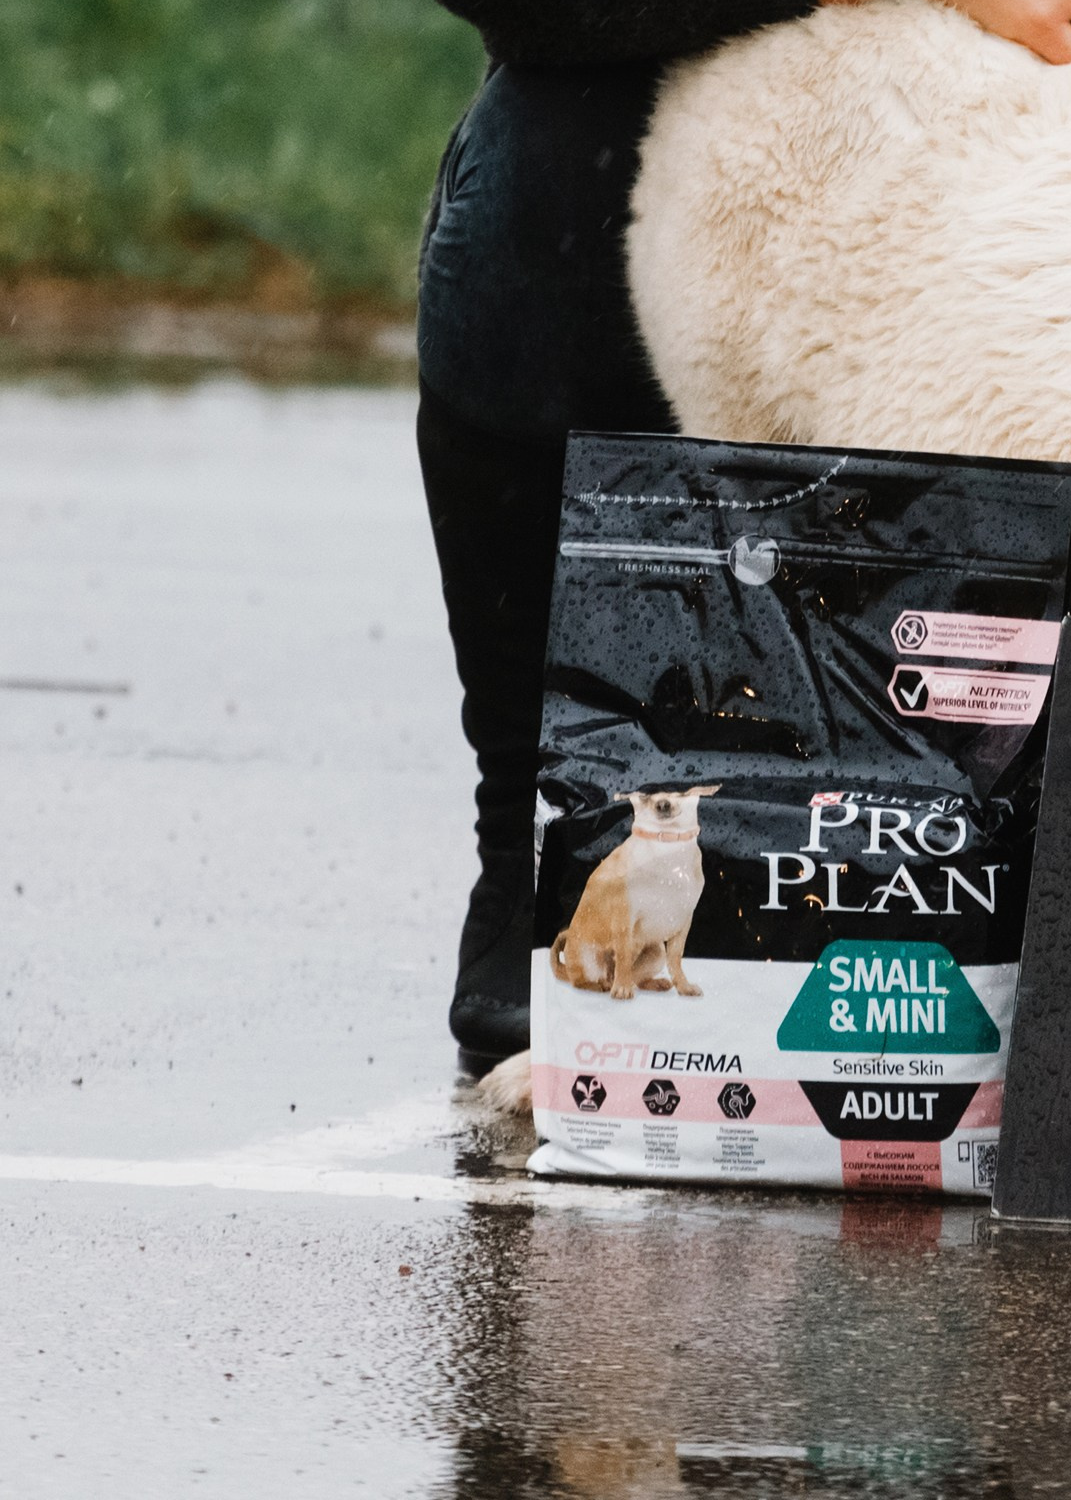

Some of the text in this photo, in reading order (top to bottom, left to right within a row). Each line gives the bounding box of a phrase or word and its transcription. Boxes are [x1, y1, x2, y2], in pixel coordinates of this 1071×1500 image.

[618, 563, 711, 575] FRESHNESS SEAL
[932, 697, 967, 709] SUPERIOR
[968, 699, 989, 710] LEVEL
[989, 701, 999, 710] OF
[799, 802, 967, 857] PRO
[760, 852, 1000, 915] PLAN
[829, 956, 948, 995] SMALL
[829, 998, 947, 1034] & MINI
[832, 1058, 944, 1077] Sensitive Skin
[840, 1091, 939, 1121] ADULT
[843, 1162, 940, 1172] СОДЕРЖАНИЕМ ЛОСОСЯ
[873, 1152, 915, 1160] ВЫСОКИМ
